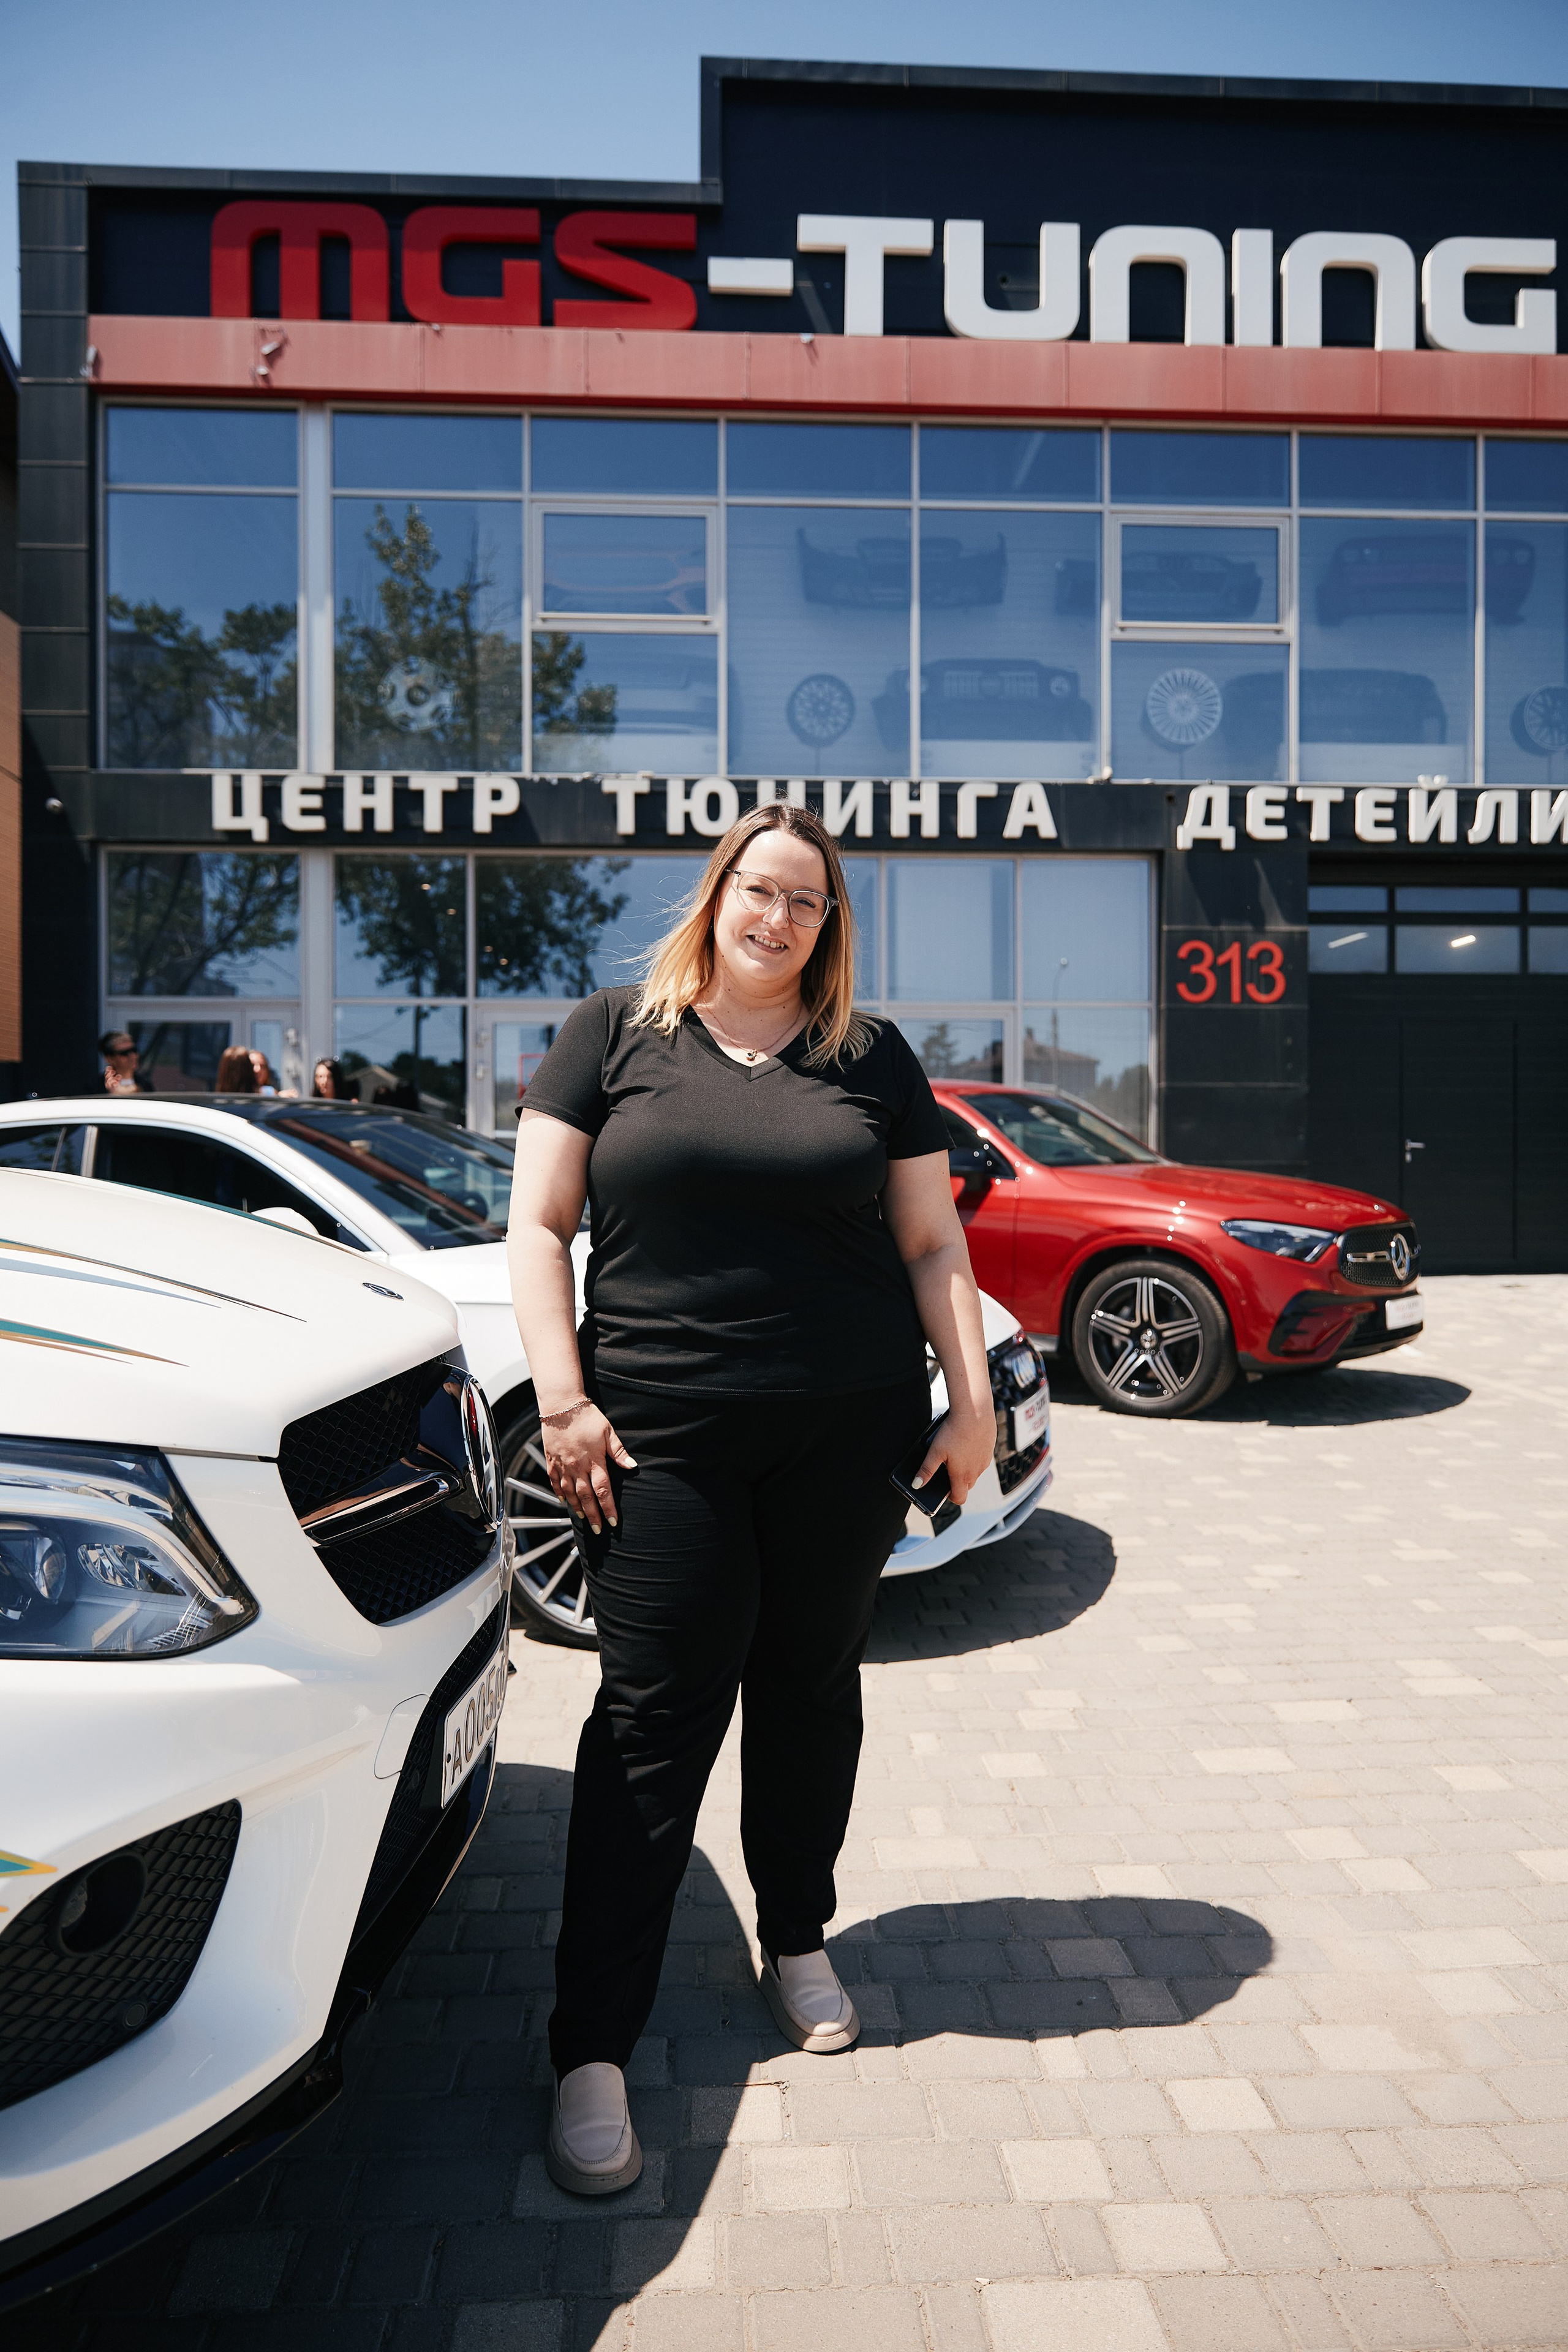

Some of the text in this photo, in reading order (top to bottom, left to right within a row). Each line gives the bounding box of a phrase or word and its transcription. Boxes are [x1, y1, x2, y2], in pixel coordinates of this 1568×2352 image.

[212, 774, 521, 842] ЦЕНТР
[1176, 775, 1568, 850] ДЕТЕЙЛИ
[1176, 940, 1286, 1003] 313
